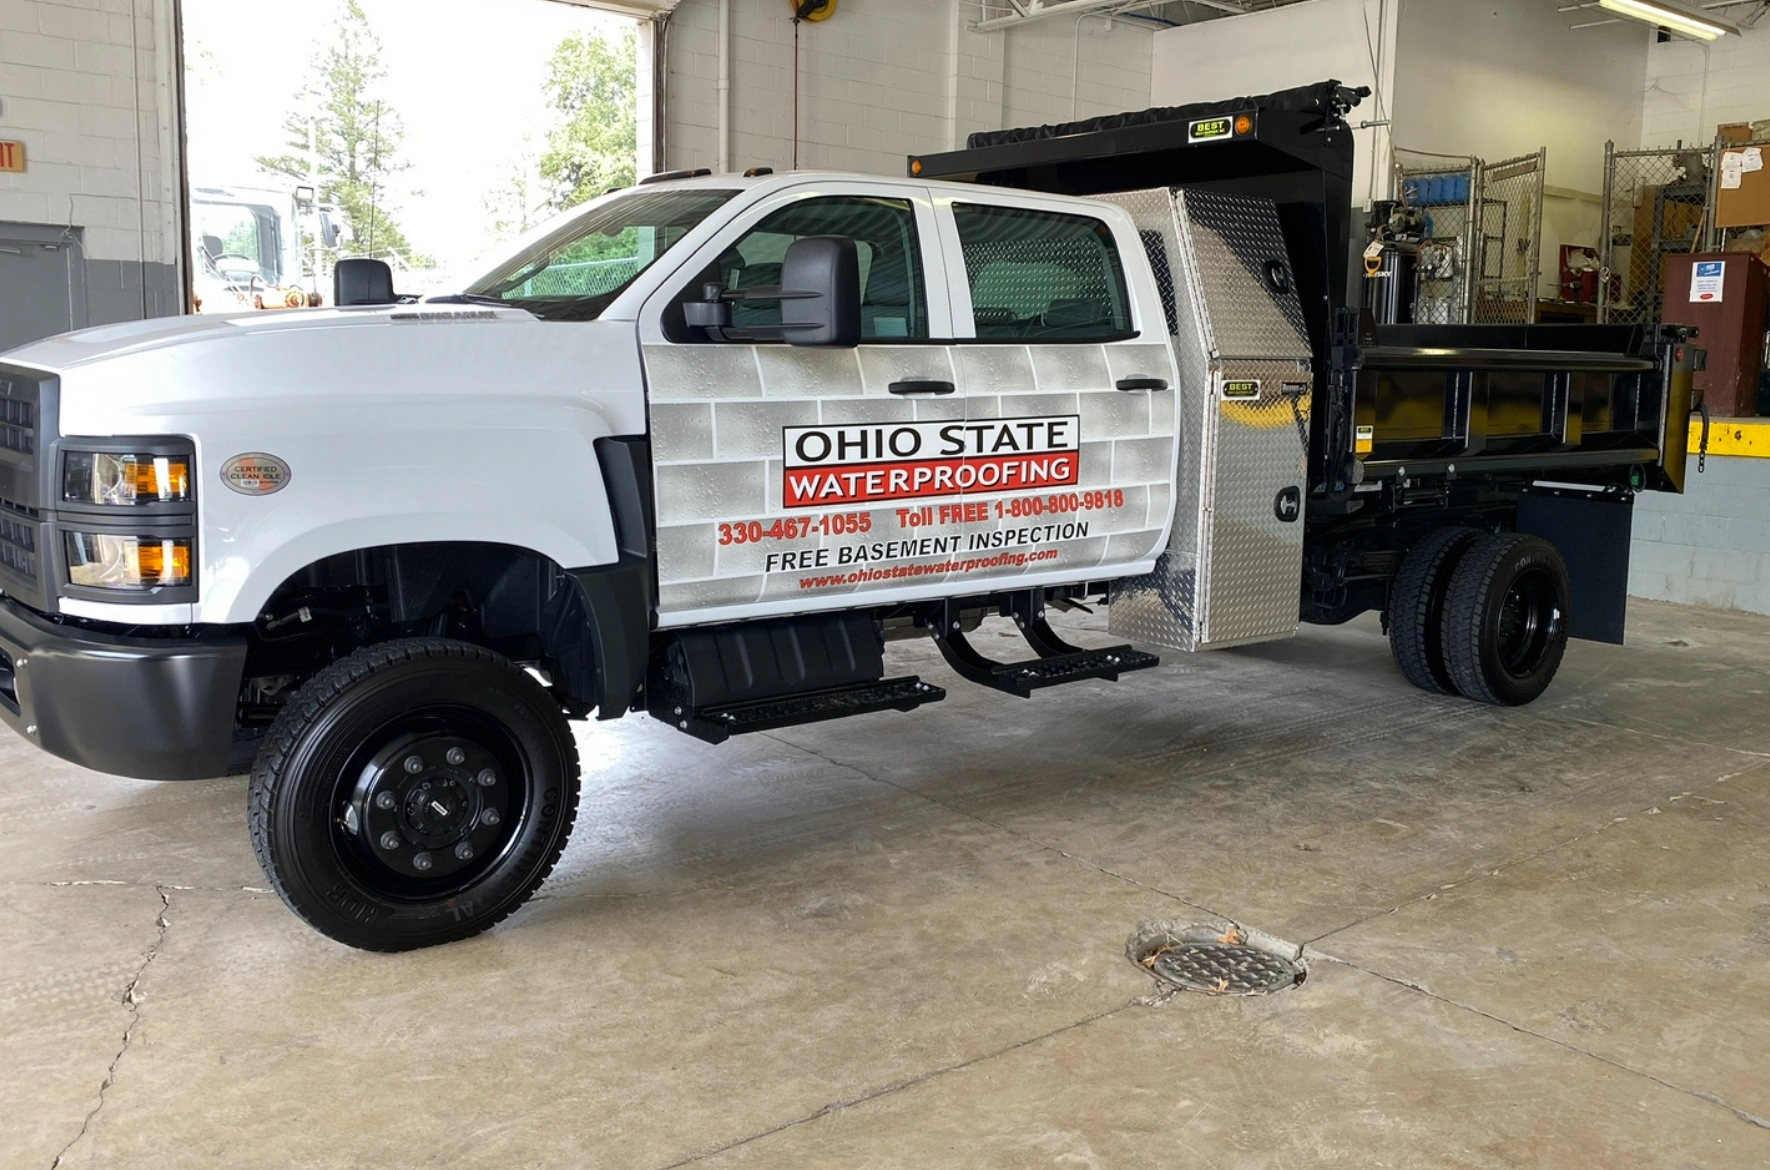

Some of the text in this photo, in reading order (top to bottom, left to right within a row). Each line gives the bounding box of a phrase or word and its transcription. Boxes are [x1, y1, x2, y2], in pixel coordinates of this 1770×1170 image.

[1196, 121, 1225, 132] BEST
[1229, 383, 1253, 391] BEST
[795, 421, 1068, 463] OHIO STATE
[789, 457, 1070, 501] WATERPROOFING
[718, 512, 873, 546] 330-467-1055
[896, 489, 1125, 529] Toll FREE 1-800-800-9818
[765, 521, 1089, 573] FREE BASEMENT INSPECTION
[799, 549, 1058, 589] www.ohiostatewaterproofing.com
